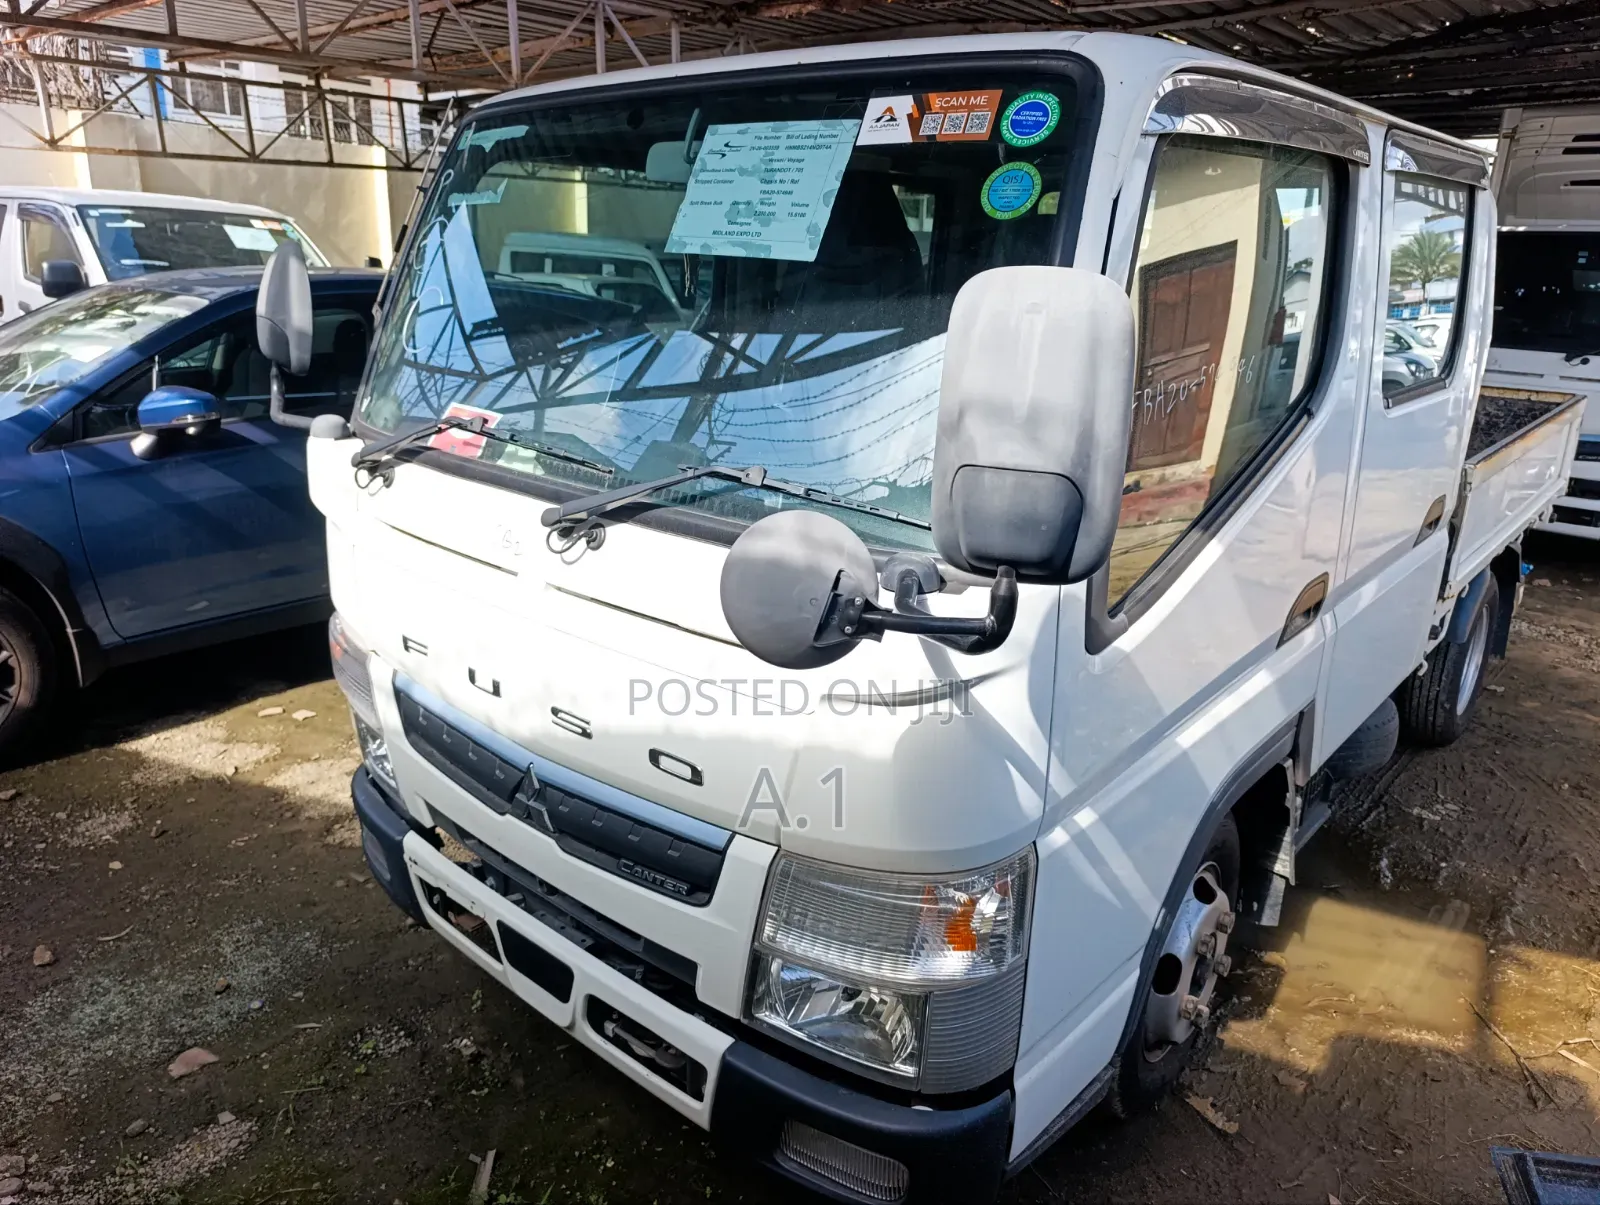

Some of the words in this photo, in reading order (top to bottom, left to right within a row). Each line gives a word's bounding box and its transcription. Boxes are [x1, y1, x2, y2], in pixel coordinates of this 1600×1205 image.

[935, 96, 967, 107] SCAN
[969, 95, 989, 105] ME
[1005, 93, 1035, 116] QUALITY
[1036, 93, 1059, 127] INSPECTION
[801, 133, 818, 141] Lading
[1002, 175, 1024, 184] QISJ
[402, 634, 704, 787] FUSO
[617, 858, 690, 896] CANTER
